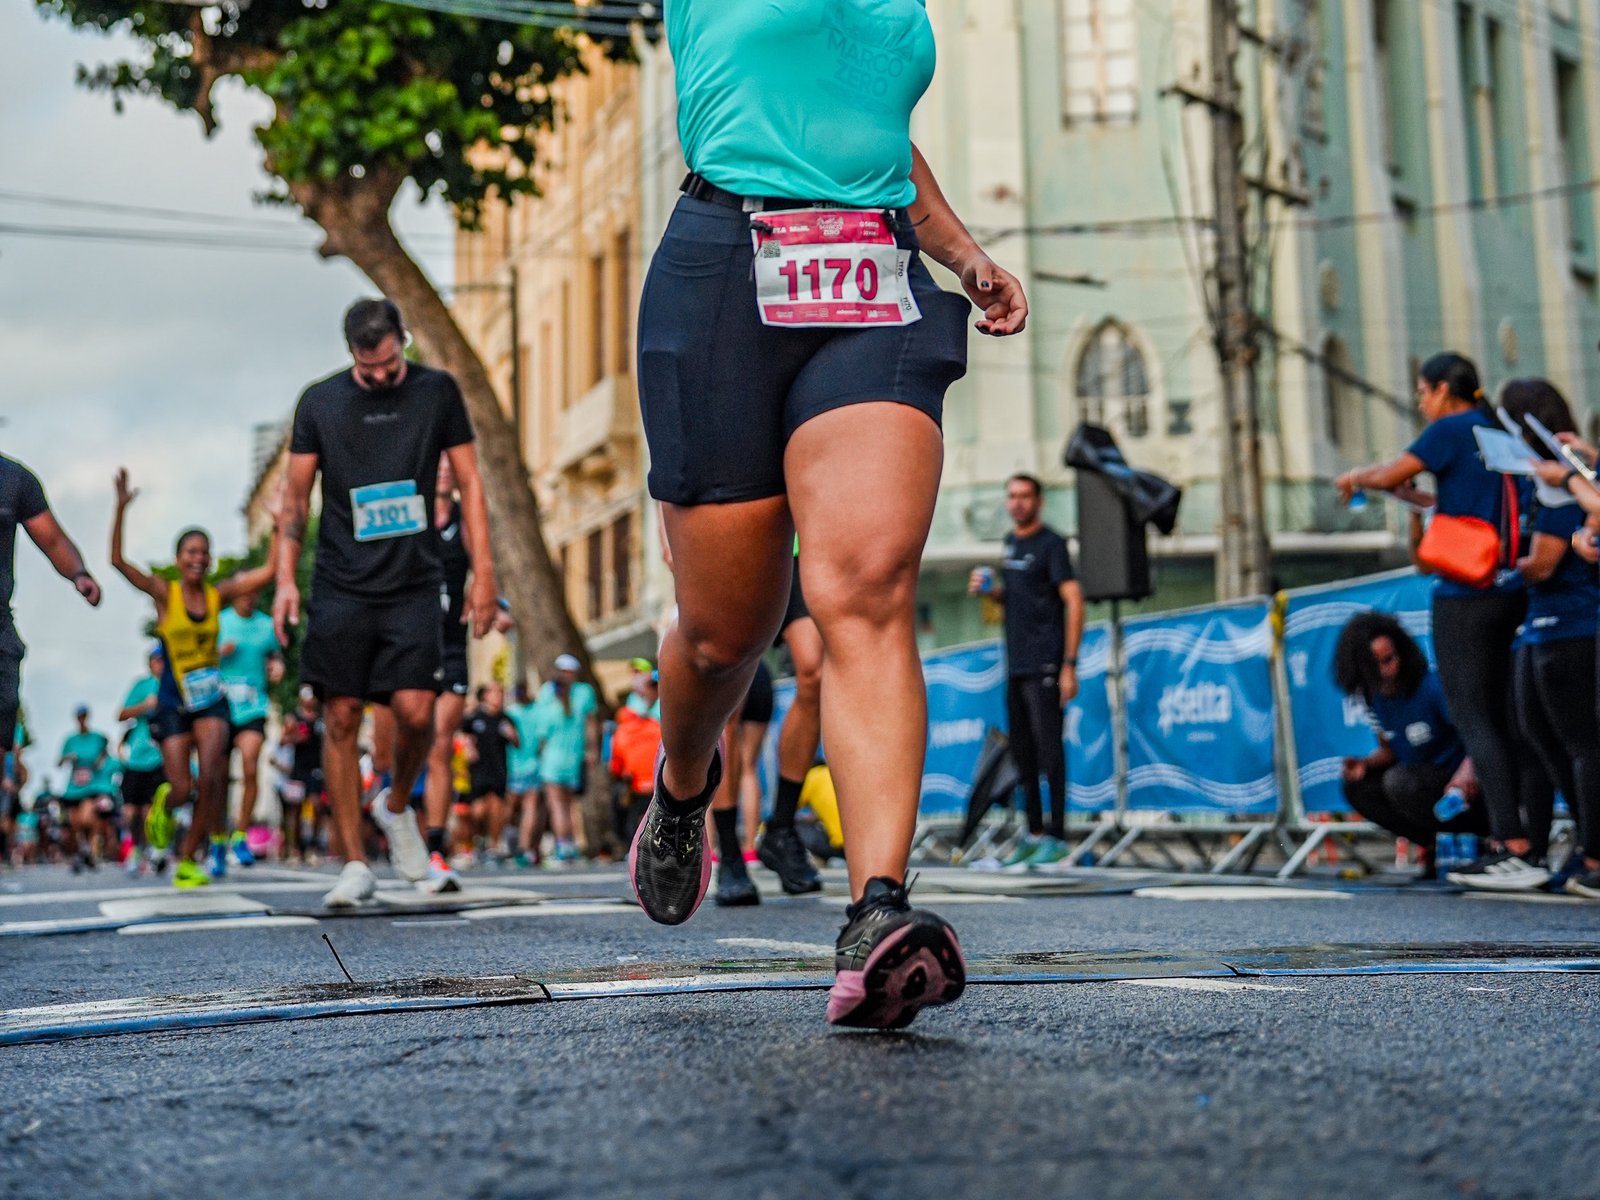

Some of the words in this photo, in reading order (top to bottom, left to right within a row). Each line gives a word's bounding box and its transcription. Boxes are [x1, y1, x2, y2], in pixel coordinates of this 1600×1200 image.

[827, 30, 904, 78] MARCO
[833, 59, 888, 97] ZERO
[778, 258, 878, 301] 1170
